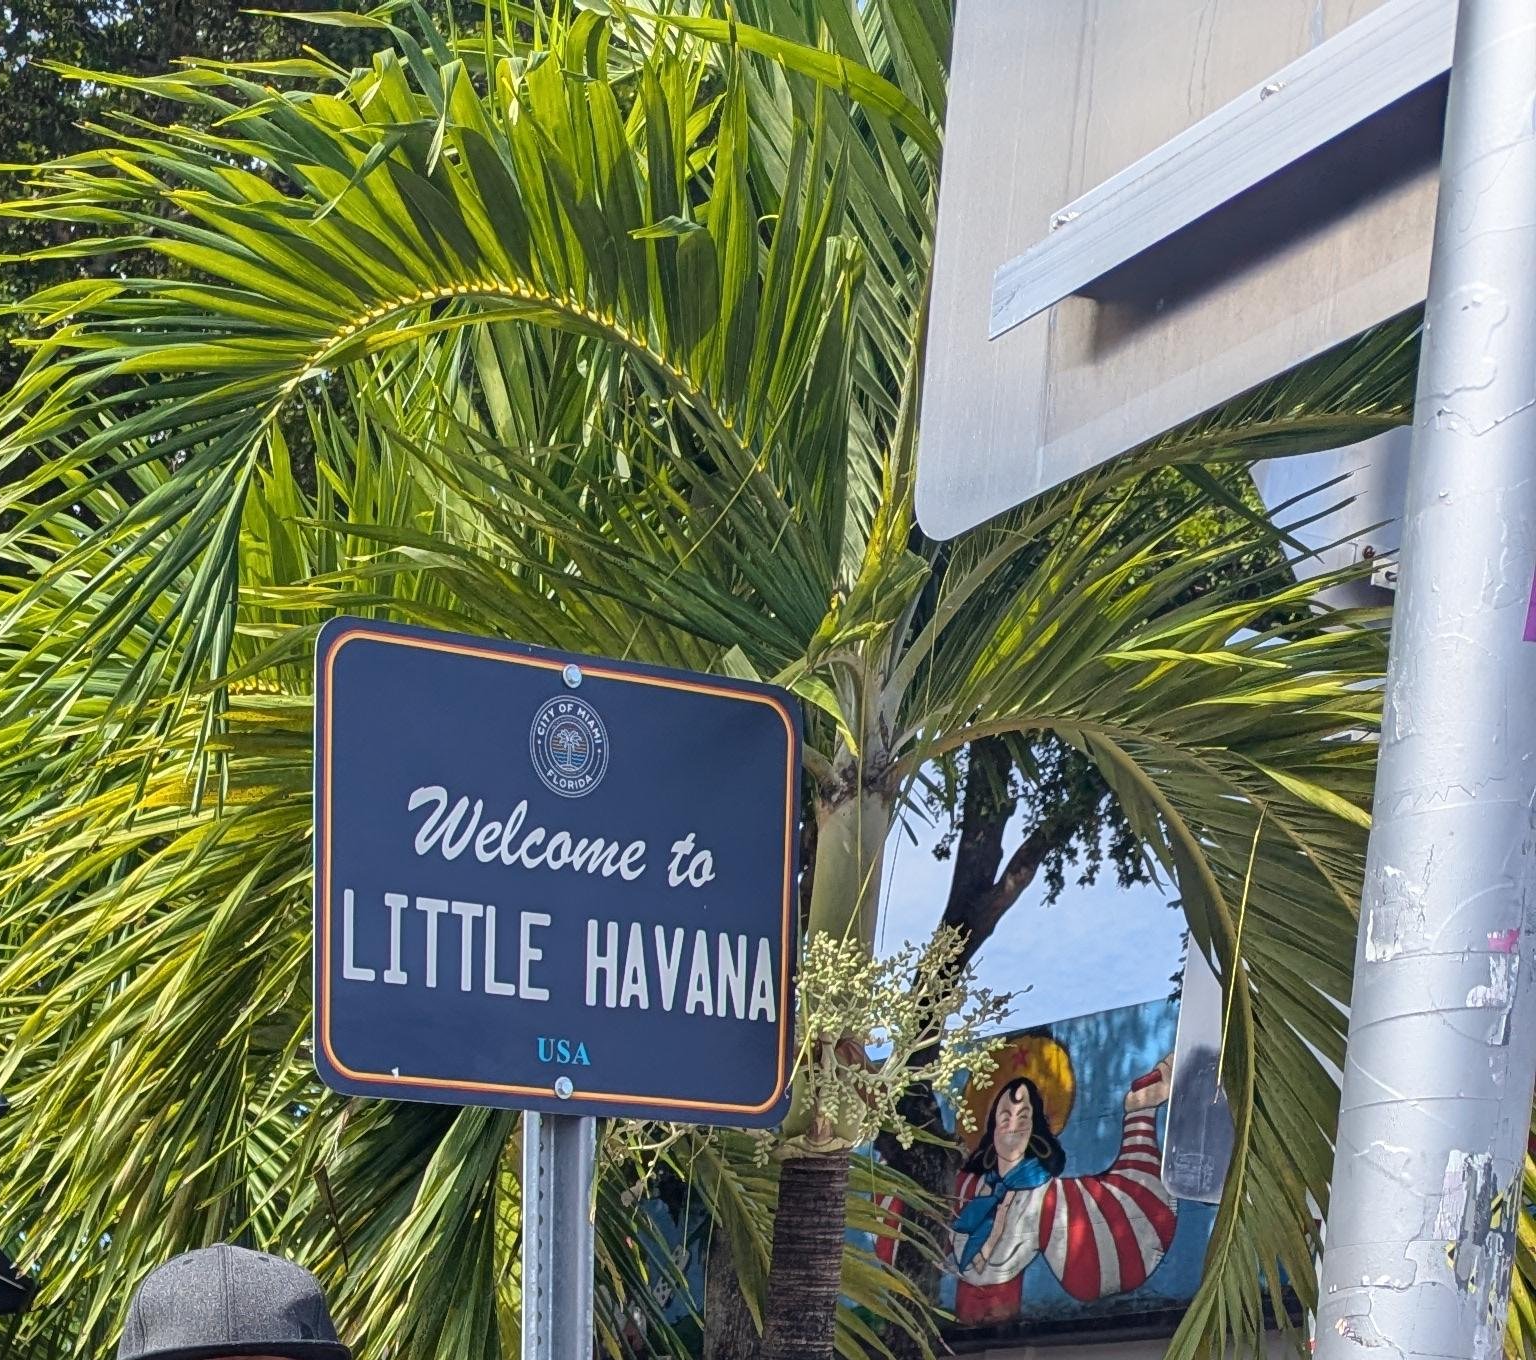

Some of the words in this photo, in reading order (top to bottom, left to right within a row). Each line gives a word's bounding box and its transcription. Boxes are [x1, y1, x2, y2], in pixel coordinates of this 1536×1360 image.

[537, 707, 555, 736] CITY
[558, 703, 574, 713] OF
[577, 707, 603, 744] MIAMI
[547, 768, 593, 790] FLORIDA
[407, 785, 647, 881] Welcome
[667, 832, 716, 888] to
[342, 888, 552, 1001] LITTLE
[585, 919, 777, 1023] HAVANA
[536, 1037, 591, 1067] USA
